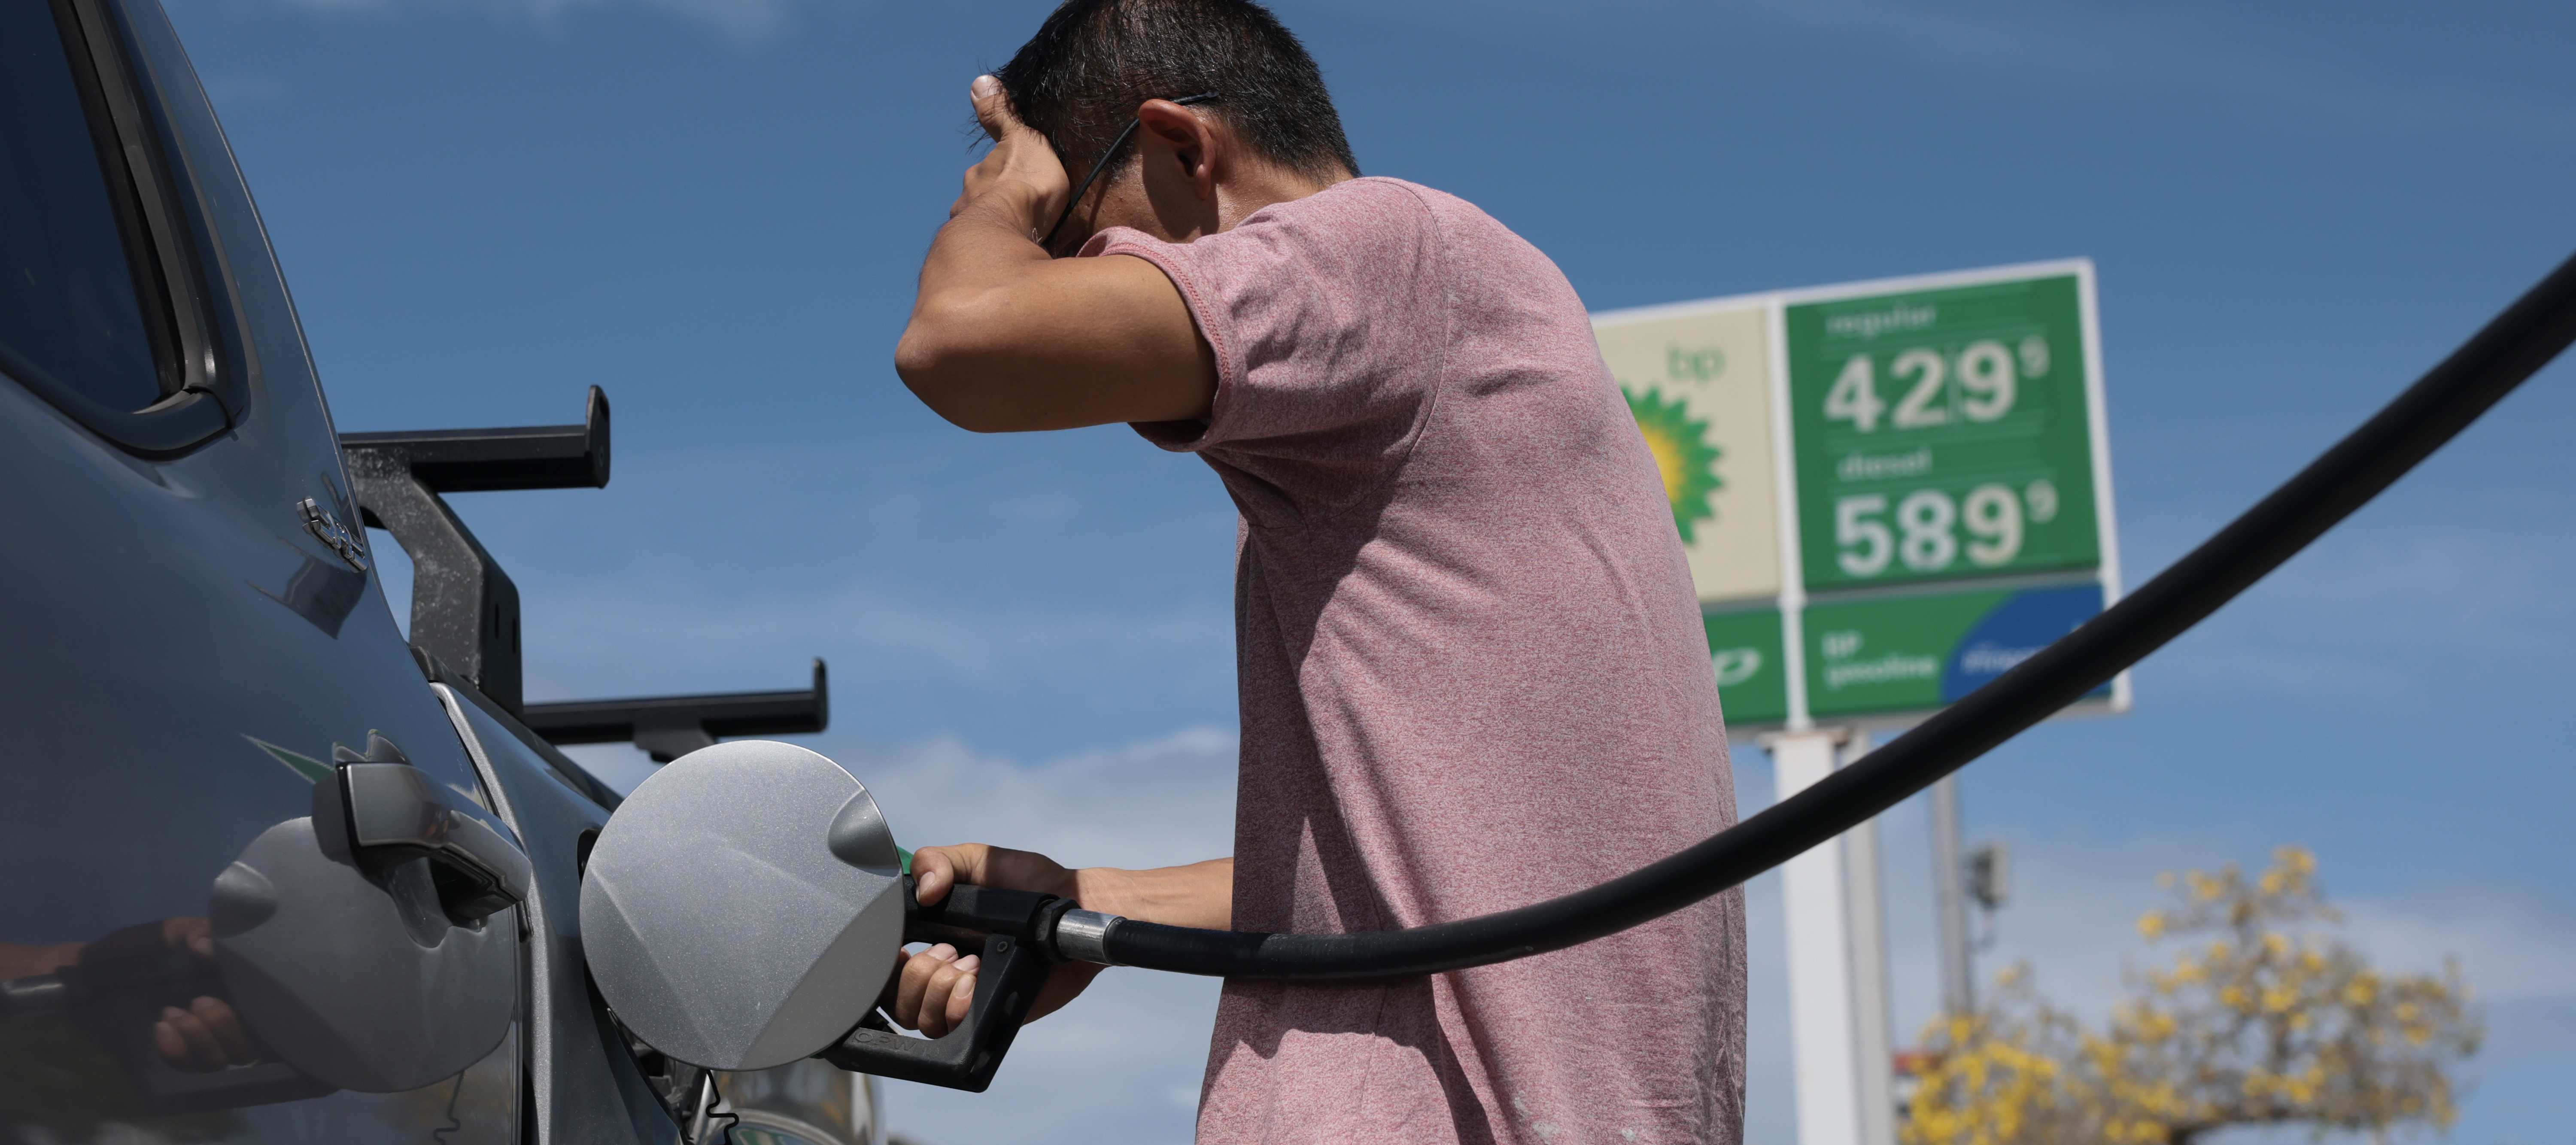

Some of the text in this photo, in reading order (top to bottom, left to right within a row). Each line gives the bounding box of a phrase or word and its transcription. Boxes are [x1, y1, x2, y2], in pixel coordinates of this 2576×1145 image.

[1829, 306, 1935, 337] regular
[1668, 343, 1725, 386] bp
[1839, 447, 1931, 480] diesel
[1823, 632, 1861, 657] BP
[1826, 655, 1936, 688] gasoline
[855, 1033, 918, 1051] OPW
